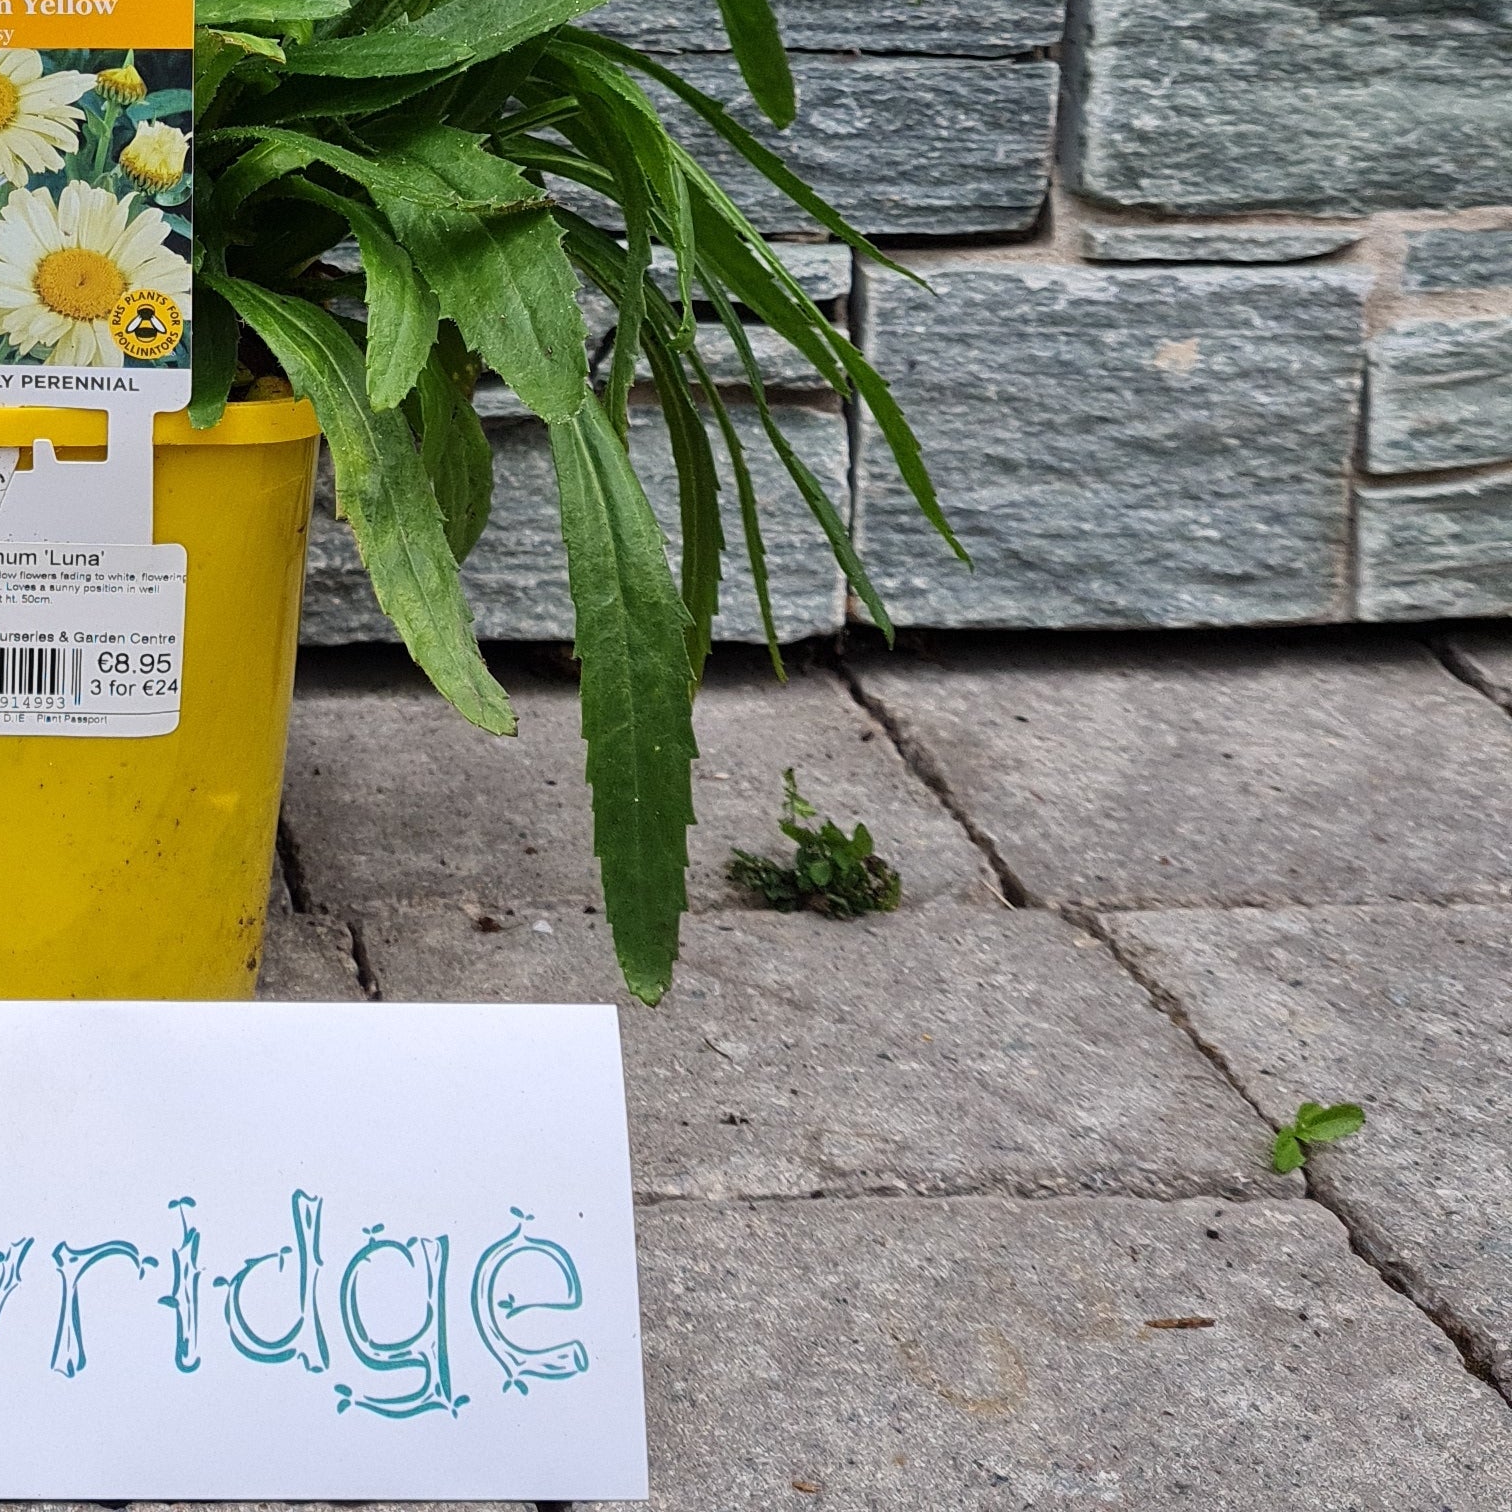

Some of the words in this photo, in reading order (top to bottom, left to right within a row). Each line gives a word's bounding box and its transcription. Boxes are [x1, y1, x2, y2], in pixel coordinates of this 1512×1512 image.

[112, 305, 126, 325] RHS
[124, 291, 168, 306] PLANTS
[167, 305, 181, 326] FOR
[114, 331, 179, 357] POLLINATORS
[21, 374, 140, 392] PERENNIAL
[44, 549, 105, 566] 'Luna'
[19, 571, 57, 580] flowers
[60, 572, 91, 582] fading
[95, 573, 105, 581] to
[6, 583, 36, 591] Loves
[50, 585, 80, 593] sunny
[83, 584, 123, 594] position
[127, 585, 135, 593] in
[139, 585, 160, 593] well
[59, 631, 69, 643] &
[74, 631, 125, 644] Garden
[130, 632, 176, 644] Centre
[97, 651, 172, 674] €8.95
[90, 679, 102, 695] 3
[109, 680, 136, 696] for
[142, 678, 179, 697] €24
[0, 696, 66, 709] 914993
[37, 714, 61, 723] Plant
[64, 714, 107, 724] Passport
